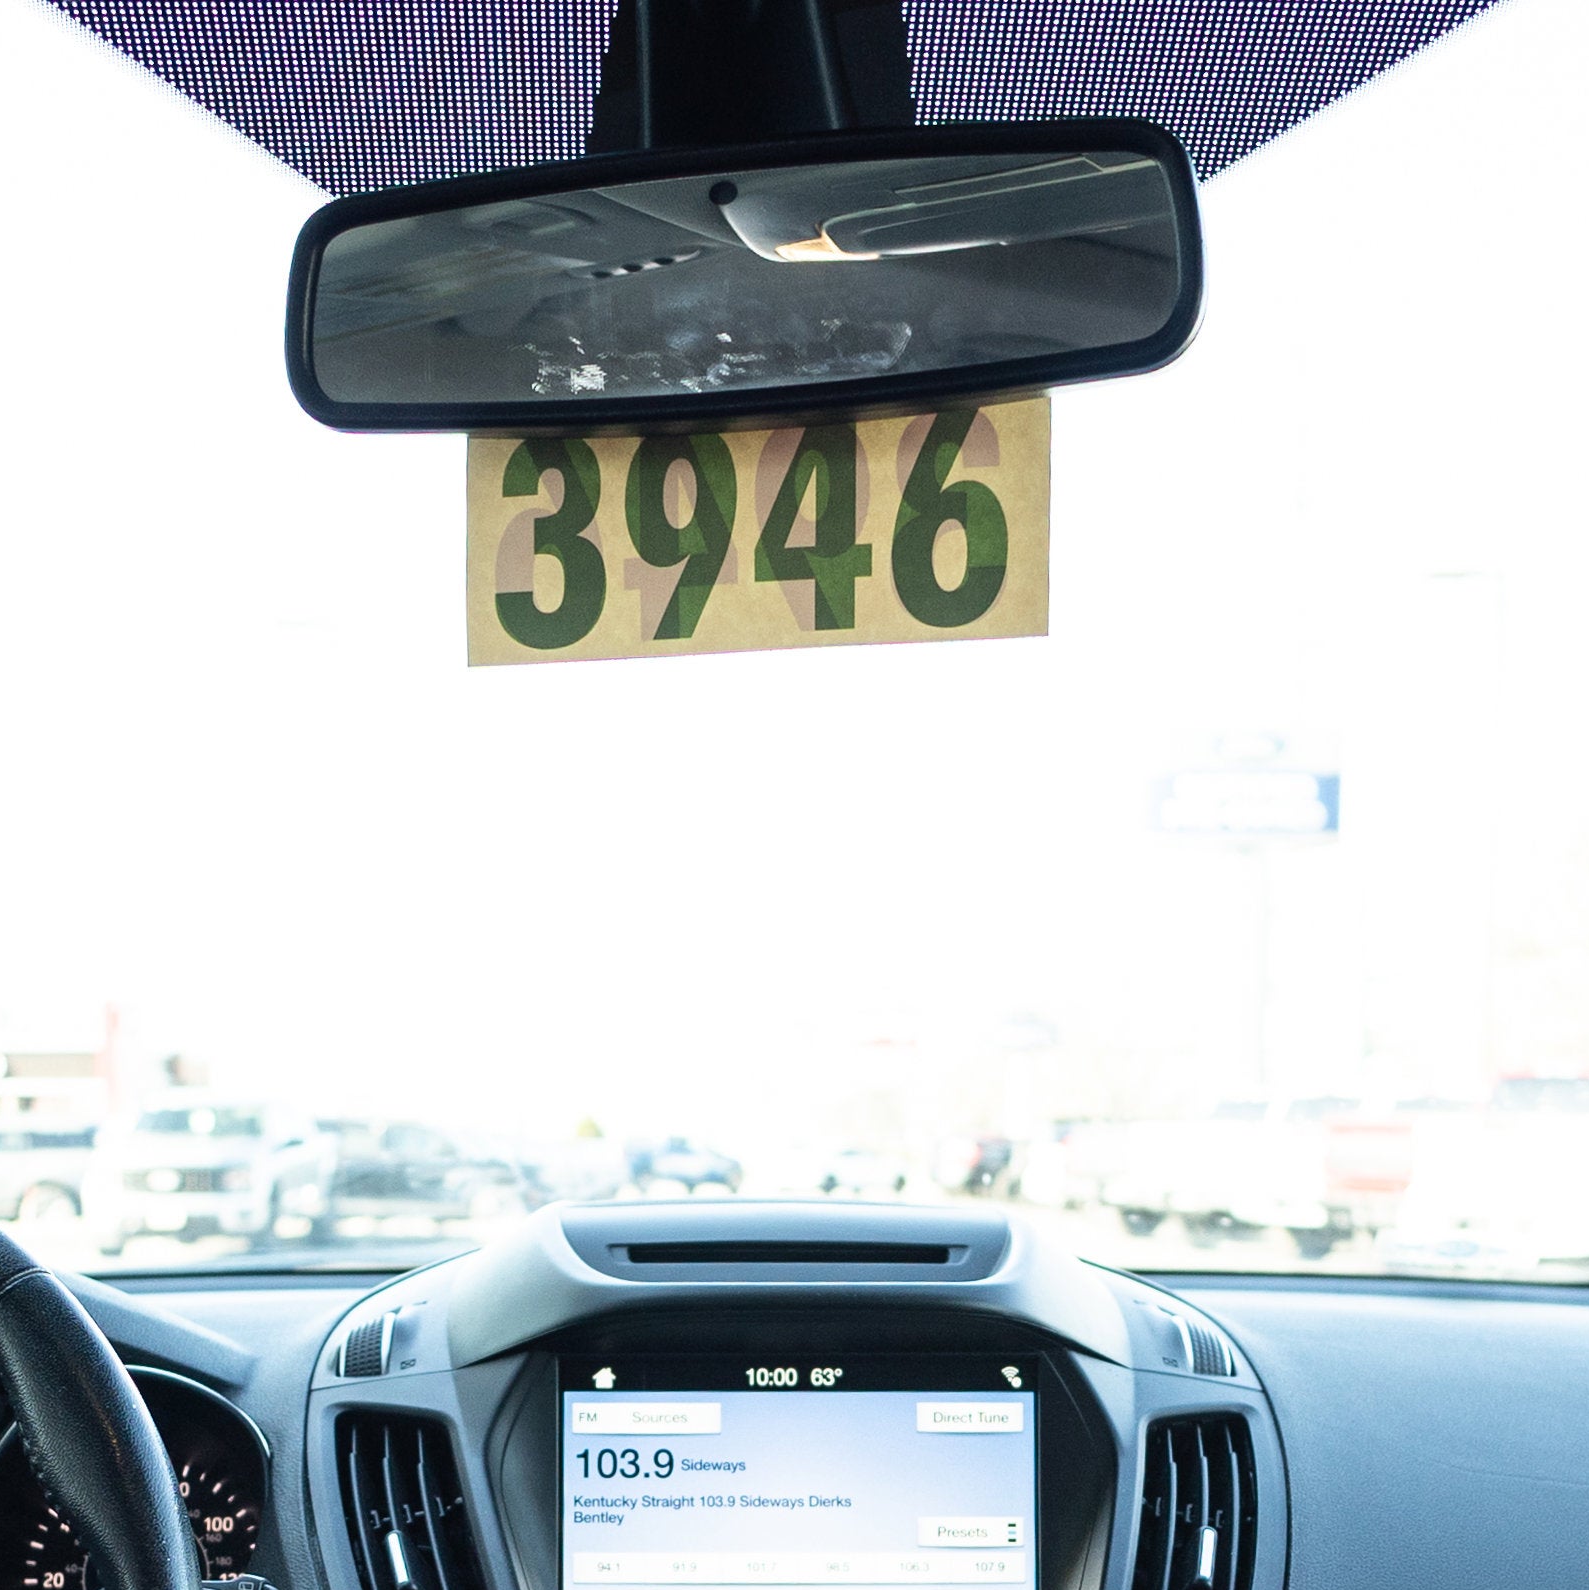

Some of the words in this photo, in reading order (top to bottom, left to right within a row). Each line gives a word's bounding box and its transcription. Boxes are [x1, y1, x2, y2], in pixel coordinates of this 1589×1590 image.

[495, 405, 1009, 650] 3946
[745, 1367, 798, 1387] 10:00
[810, 1367, 843, 1387] 63°
[578, 1412, 598, 1422] FM
[631, 1411, 688, 1424] Sources
[933, 1411, 973, 1424] Direct
[978, 1411, 1010, 1424] Tune
[575, 1447, 675, 1479] 103.9
[680, 1458, 747, 1474] Sideways
[178, 1481, 191, 1498] 0
[573, 1495, 638, 1510] Kentucky
[641, 1494, 695, 1510] Straight
[699, 1495, 736, 1508] 103.9
[739, 1495, 805, 1510] Sideways
[808, 1495, 852, 1508] Dierks
[203, 1516, 234, 1532] 100
[573, 1511, 624, 1526] Bentley
[937, 1526, 988, 1538] Presets
[215, 1556, 232, 1566] 180
[597, 1561, 620, 1572] 94.1
[672, 1561, 697, 1572] 91.9
[975, 1561, 1005, 1572] 107.9
[43, 1572, 65, 1589] 20
